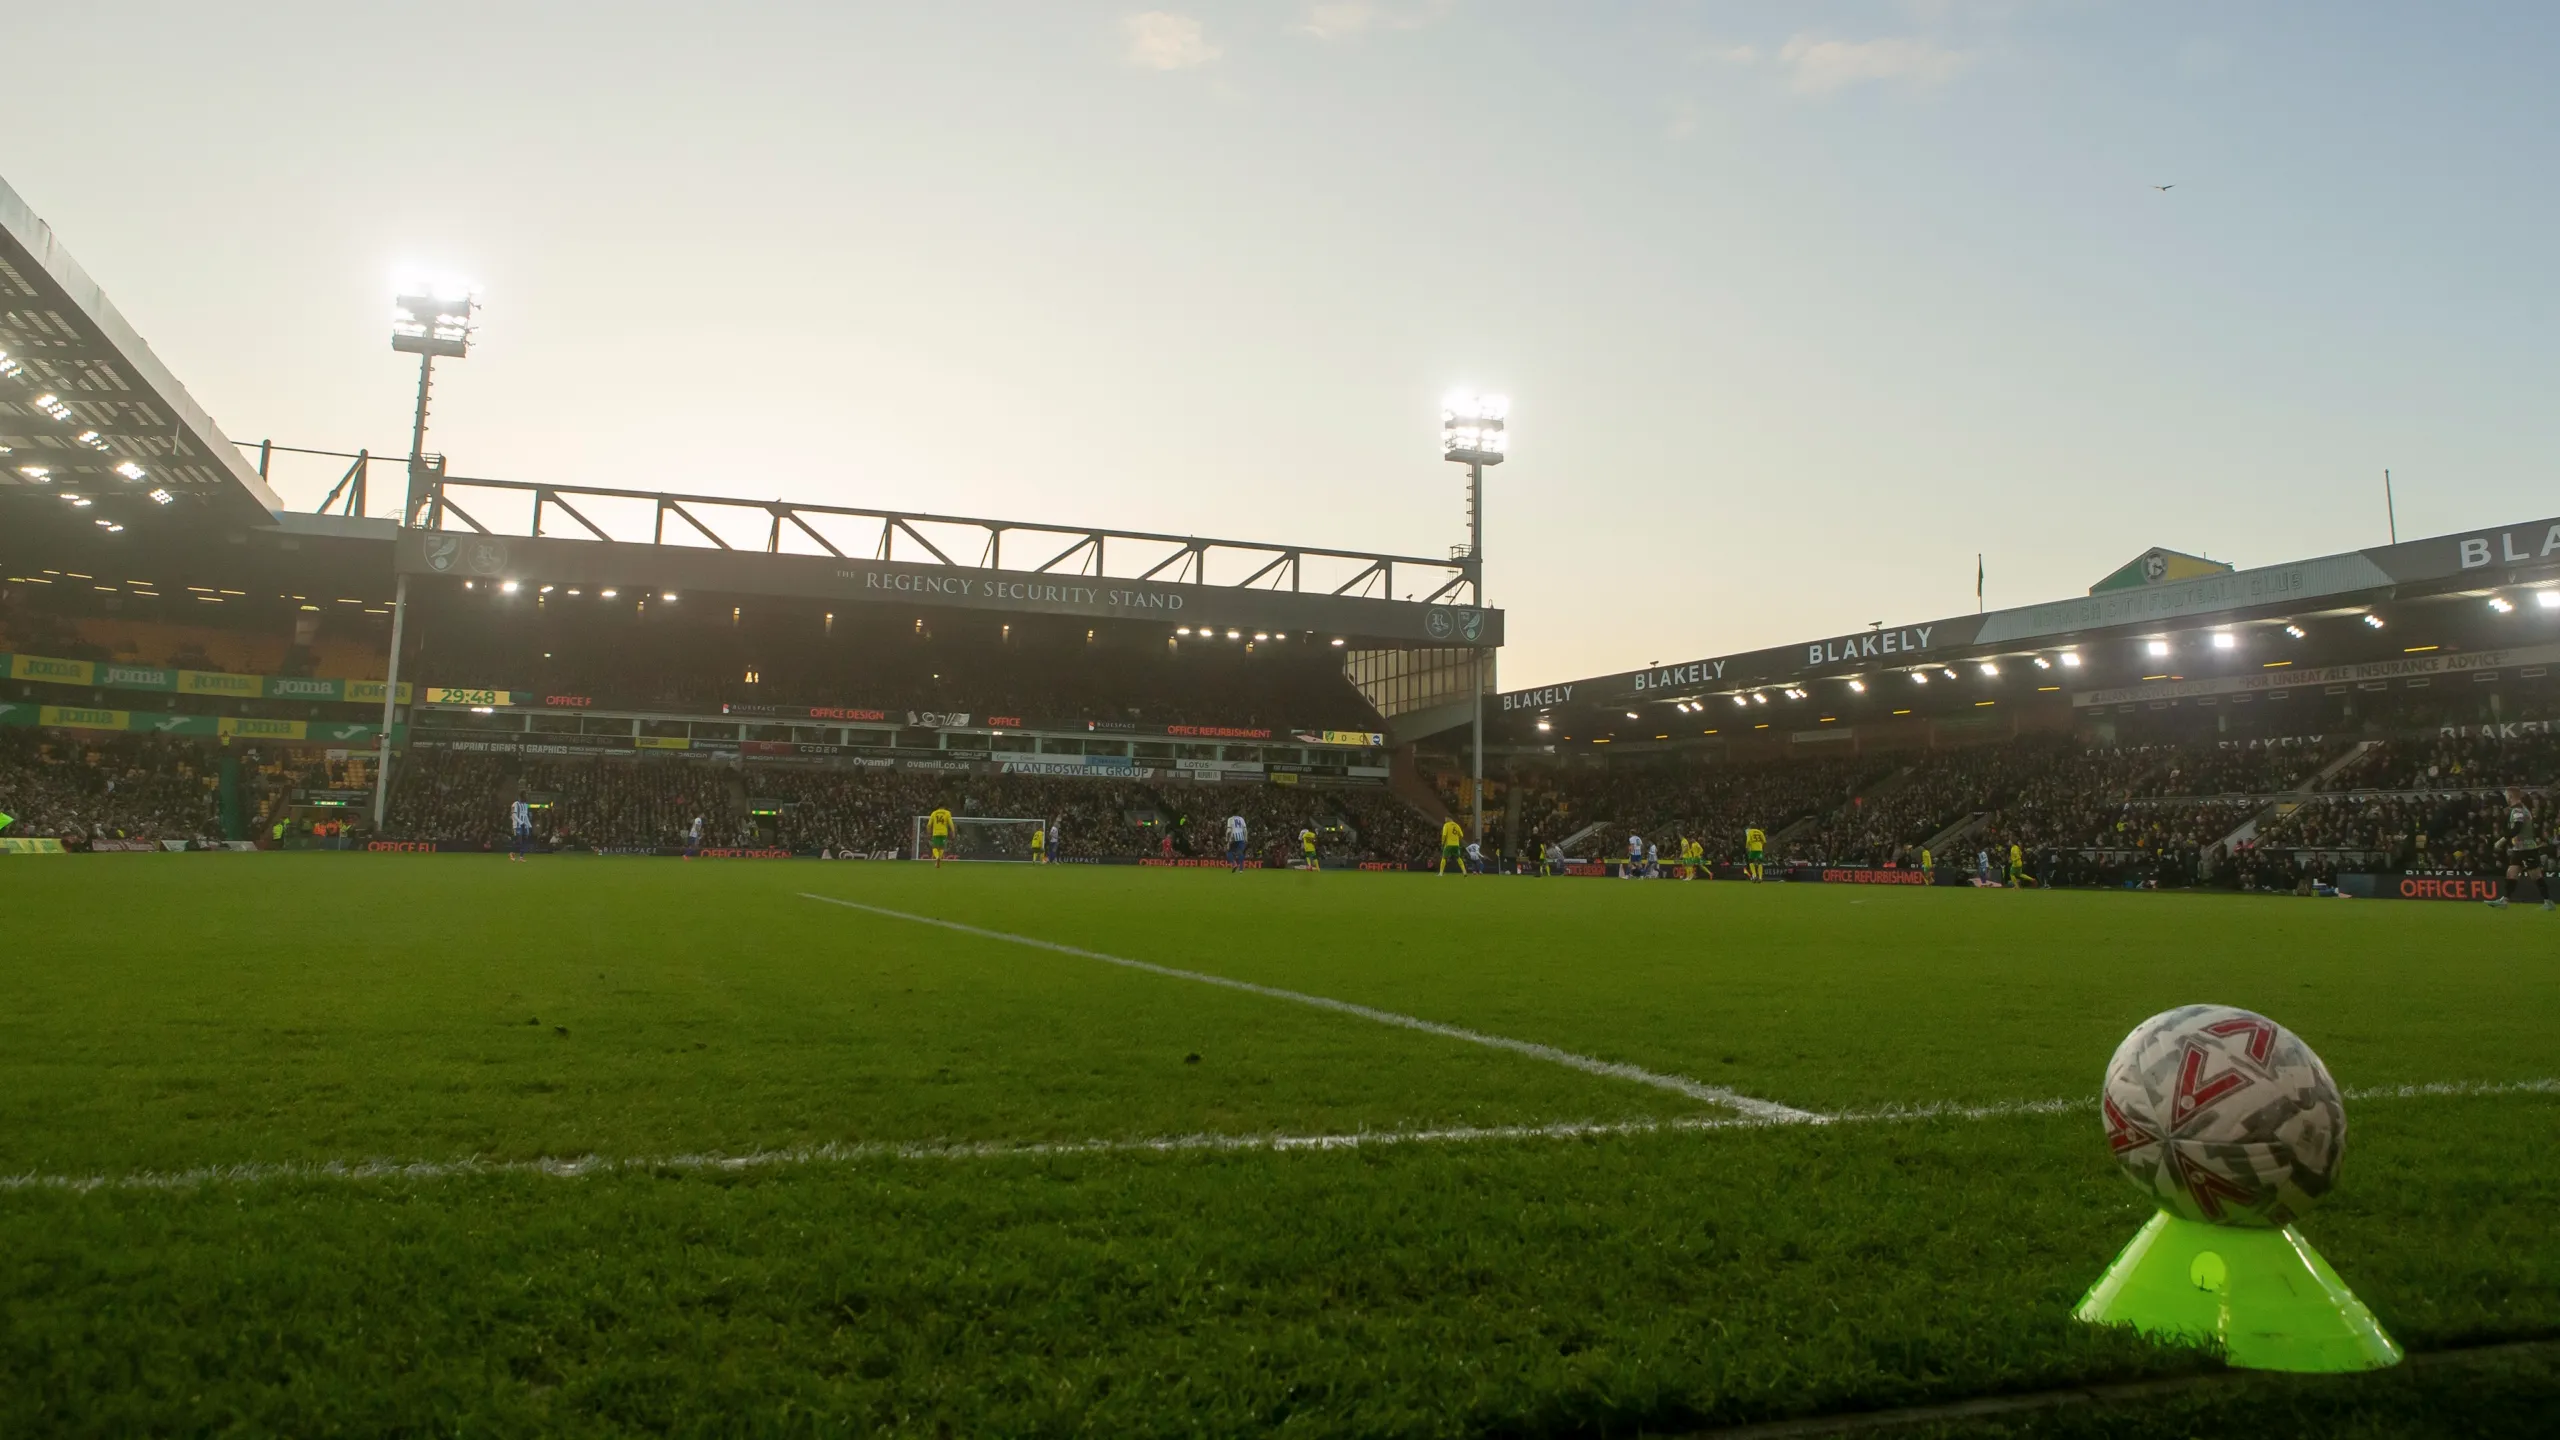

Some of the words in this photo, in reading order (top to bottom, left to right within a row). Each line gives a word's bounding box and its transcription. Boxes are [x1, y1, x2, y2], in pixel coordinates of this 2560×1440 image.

[2459, 523, 2560, 569] BLA
[836, 569, 856, 579] THE
[864, 571, 974, 595] REGENCY
[983, 580, 1099, 605] SECURITY
[1108, 589, 1184, 610] STAND
[2148, 578, 2243, 612] FOOTBALL
[2250, 568, 2301, 596] CLUB
[1809, 626, 1933, 665] BLAKELY
[1634, 660, 1726, 691] BLAKELY
[2356, 658, 2440, 679] INSURANCE
[440, 688, 496, 705] 29:48
[546, 695, 584, 706] OFFICE
[1503, 685, 1574, 711] BLAKELY
[731, 704, 775, 712] BLUESPACE
[809, 708, 845, 719] OFFICE
[846, 709, 885, 721] DESIGN
[988, 716, 1021, 727] OFFICE
[1096, 721, 1136, 729] BLUESPACE
[1167, 725, 1198, 736] OFFICE
[1199, 726, 1272, 739] REFURBISHMENT
[2440, 720, 2560, 739] BLAKEL
[452, 740, 489, 752] IMPRINT
[490, 742, 517, 753] SIGNS
[526, 744, 568, 755] GRAPHICS
[907, 759, 970, 771] ovamill.co.uk
[1007, 763, 1041, 774] ALAN
[1045, 764, 1102, 776] BOSWELL
[1105, 766, 1149, 778] GROUP
[1184, 761, 1209, 769] LOTUS
[935, 815, 945, 825] 14
[368, 841, 416, 852] OFFICE
[700, 848, 742, 858] OFFICE
[745, 848, 793, 859] DESIGN
[1177, 859, 1264, 868] REFURBISHENT
[1822, 869, 1853, 882] OFFICE
[2400, 879, 2467, 898] OFFICE
[2471, 880, 2498, 899] FU
